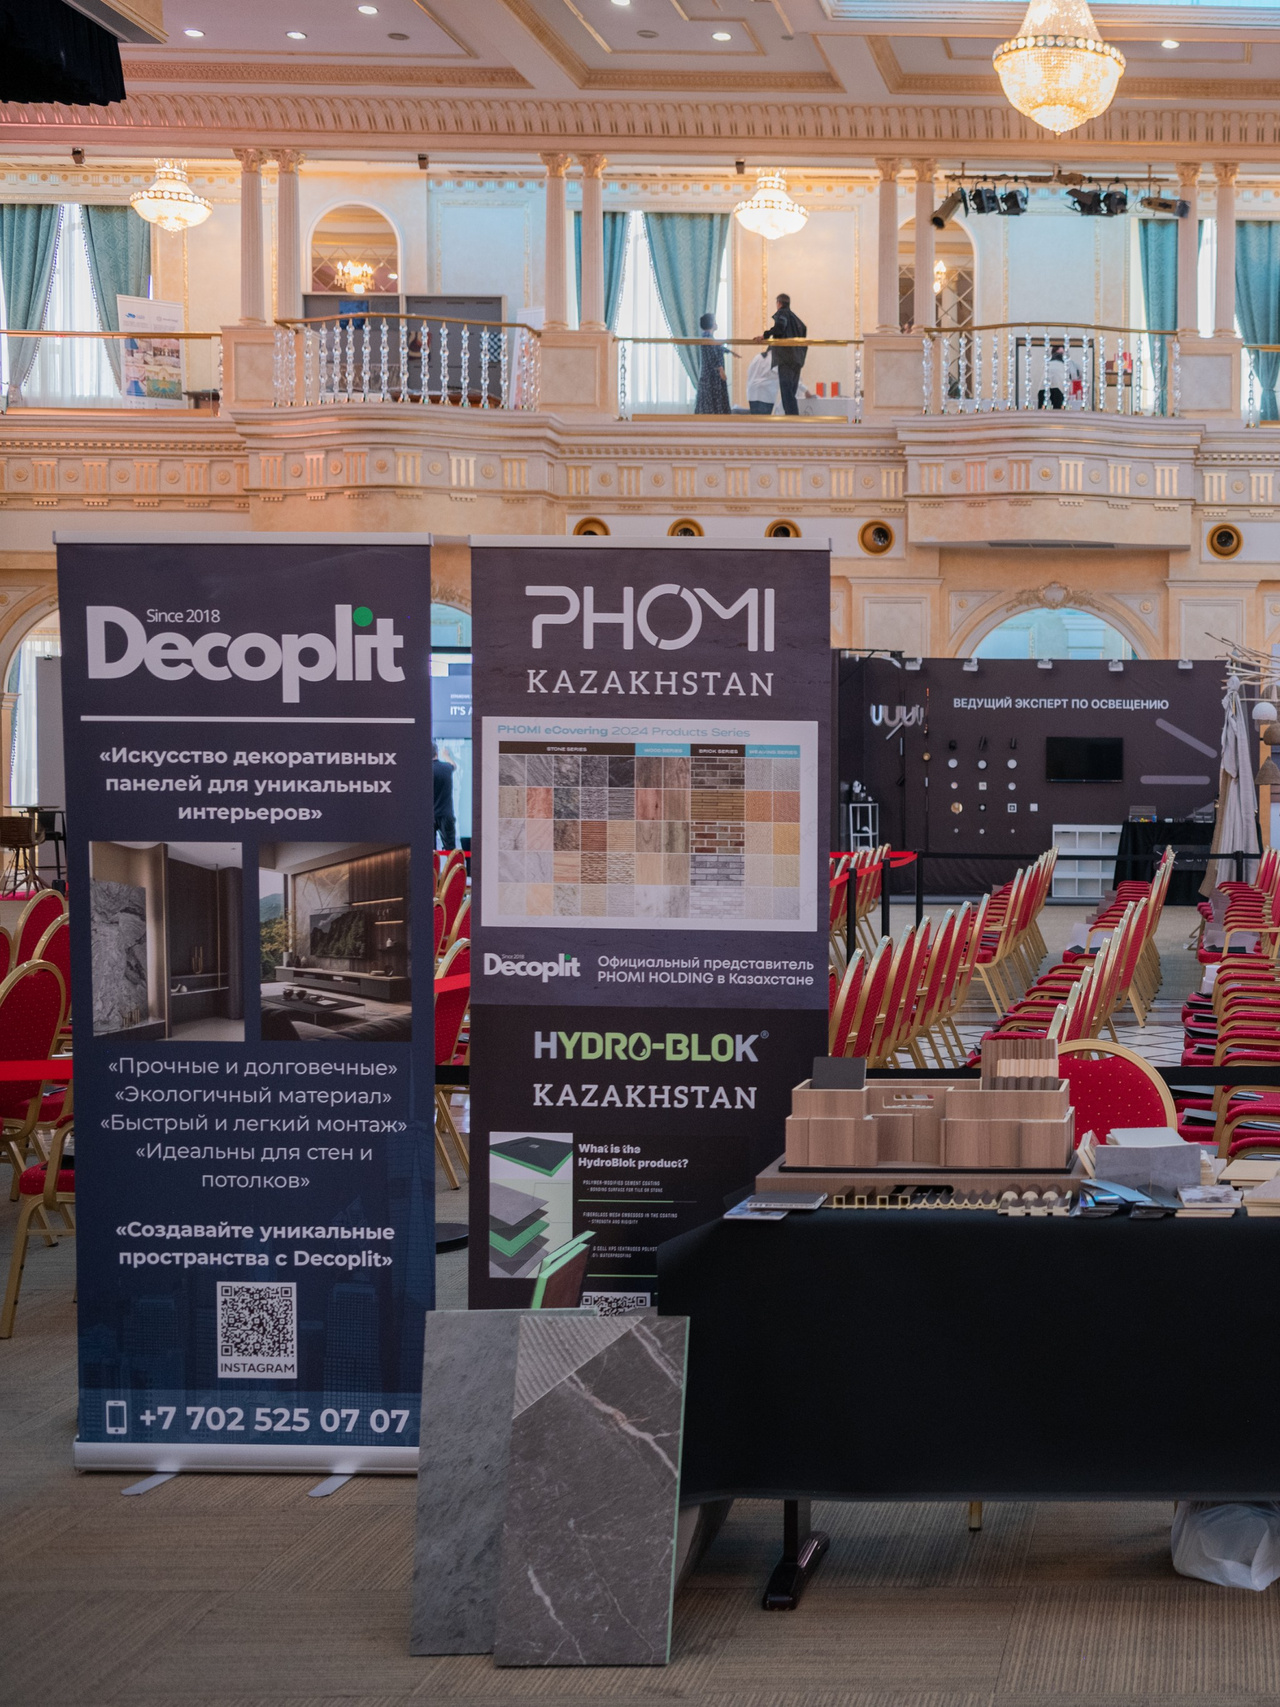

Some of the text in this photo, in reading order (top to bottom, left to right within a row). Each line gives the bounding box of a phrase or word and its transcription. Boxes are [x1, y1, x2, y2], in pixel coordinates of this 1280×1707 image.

[146, 608, 220, 623] Since 2018
[525, 583, 775, 653] PHOMI
[86, 604, 406, 703] Decoplit
[526, 669, 774, 697] KAZAKHSTAN
[450, 706, 466, 716] IT'S
[953, 696, 1170, 711] ВЕДУЩИЙ ЭКСПЕРТ ПО ОСВЕЩЕНИЮ
[497, 724, 751, 738] PHOMI eCovering 2024 Products Series
[99, 747, 397, 767] «Искусство декоративных
[105, 774, 392, 797] панелей для уникальных
[178, 805, 323, 823] интерьеров»
[484, 953, 581, 983] Decoplit
[598, 955, 814, 973] Официальный представитель
[598, 970, 814, 986] PHOMI HOLDING в Казахстане
[108, 1057, 398, 1077] «Прочные и долговечные»
[115, 1086, 392, 1106] «Экологичный материал»
[533, 1083, 757, 1109] KAZAKHSTAN
[100, 1113, 408, 1134] «Быстрый и легкий монтаж»
[136, 1143, 373, 1163] «Идеальны для стен и
[578, 1144, 641, 1154] What is the
[578, 1157, 689, 1170] HydroBlok product?
[201, 1174, 310, 1189] потолков»
[115, 1221, 396, 1243] «Создавайте уникальные
[119, 1250, 393, 1271] пространства с Decoplit»
[220, 1362, 296, 1374] INSTAGRAM
[139, 1406, 410, 1434] +7 702 525 07 07
